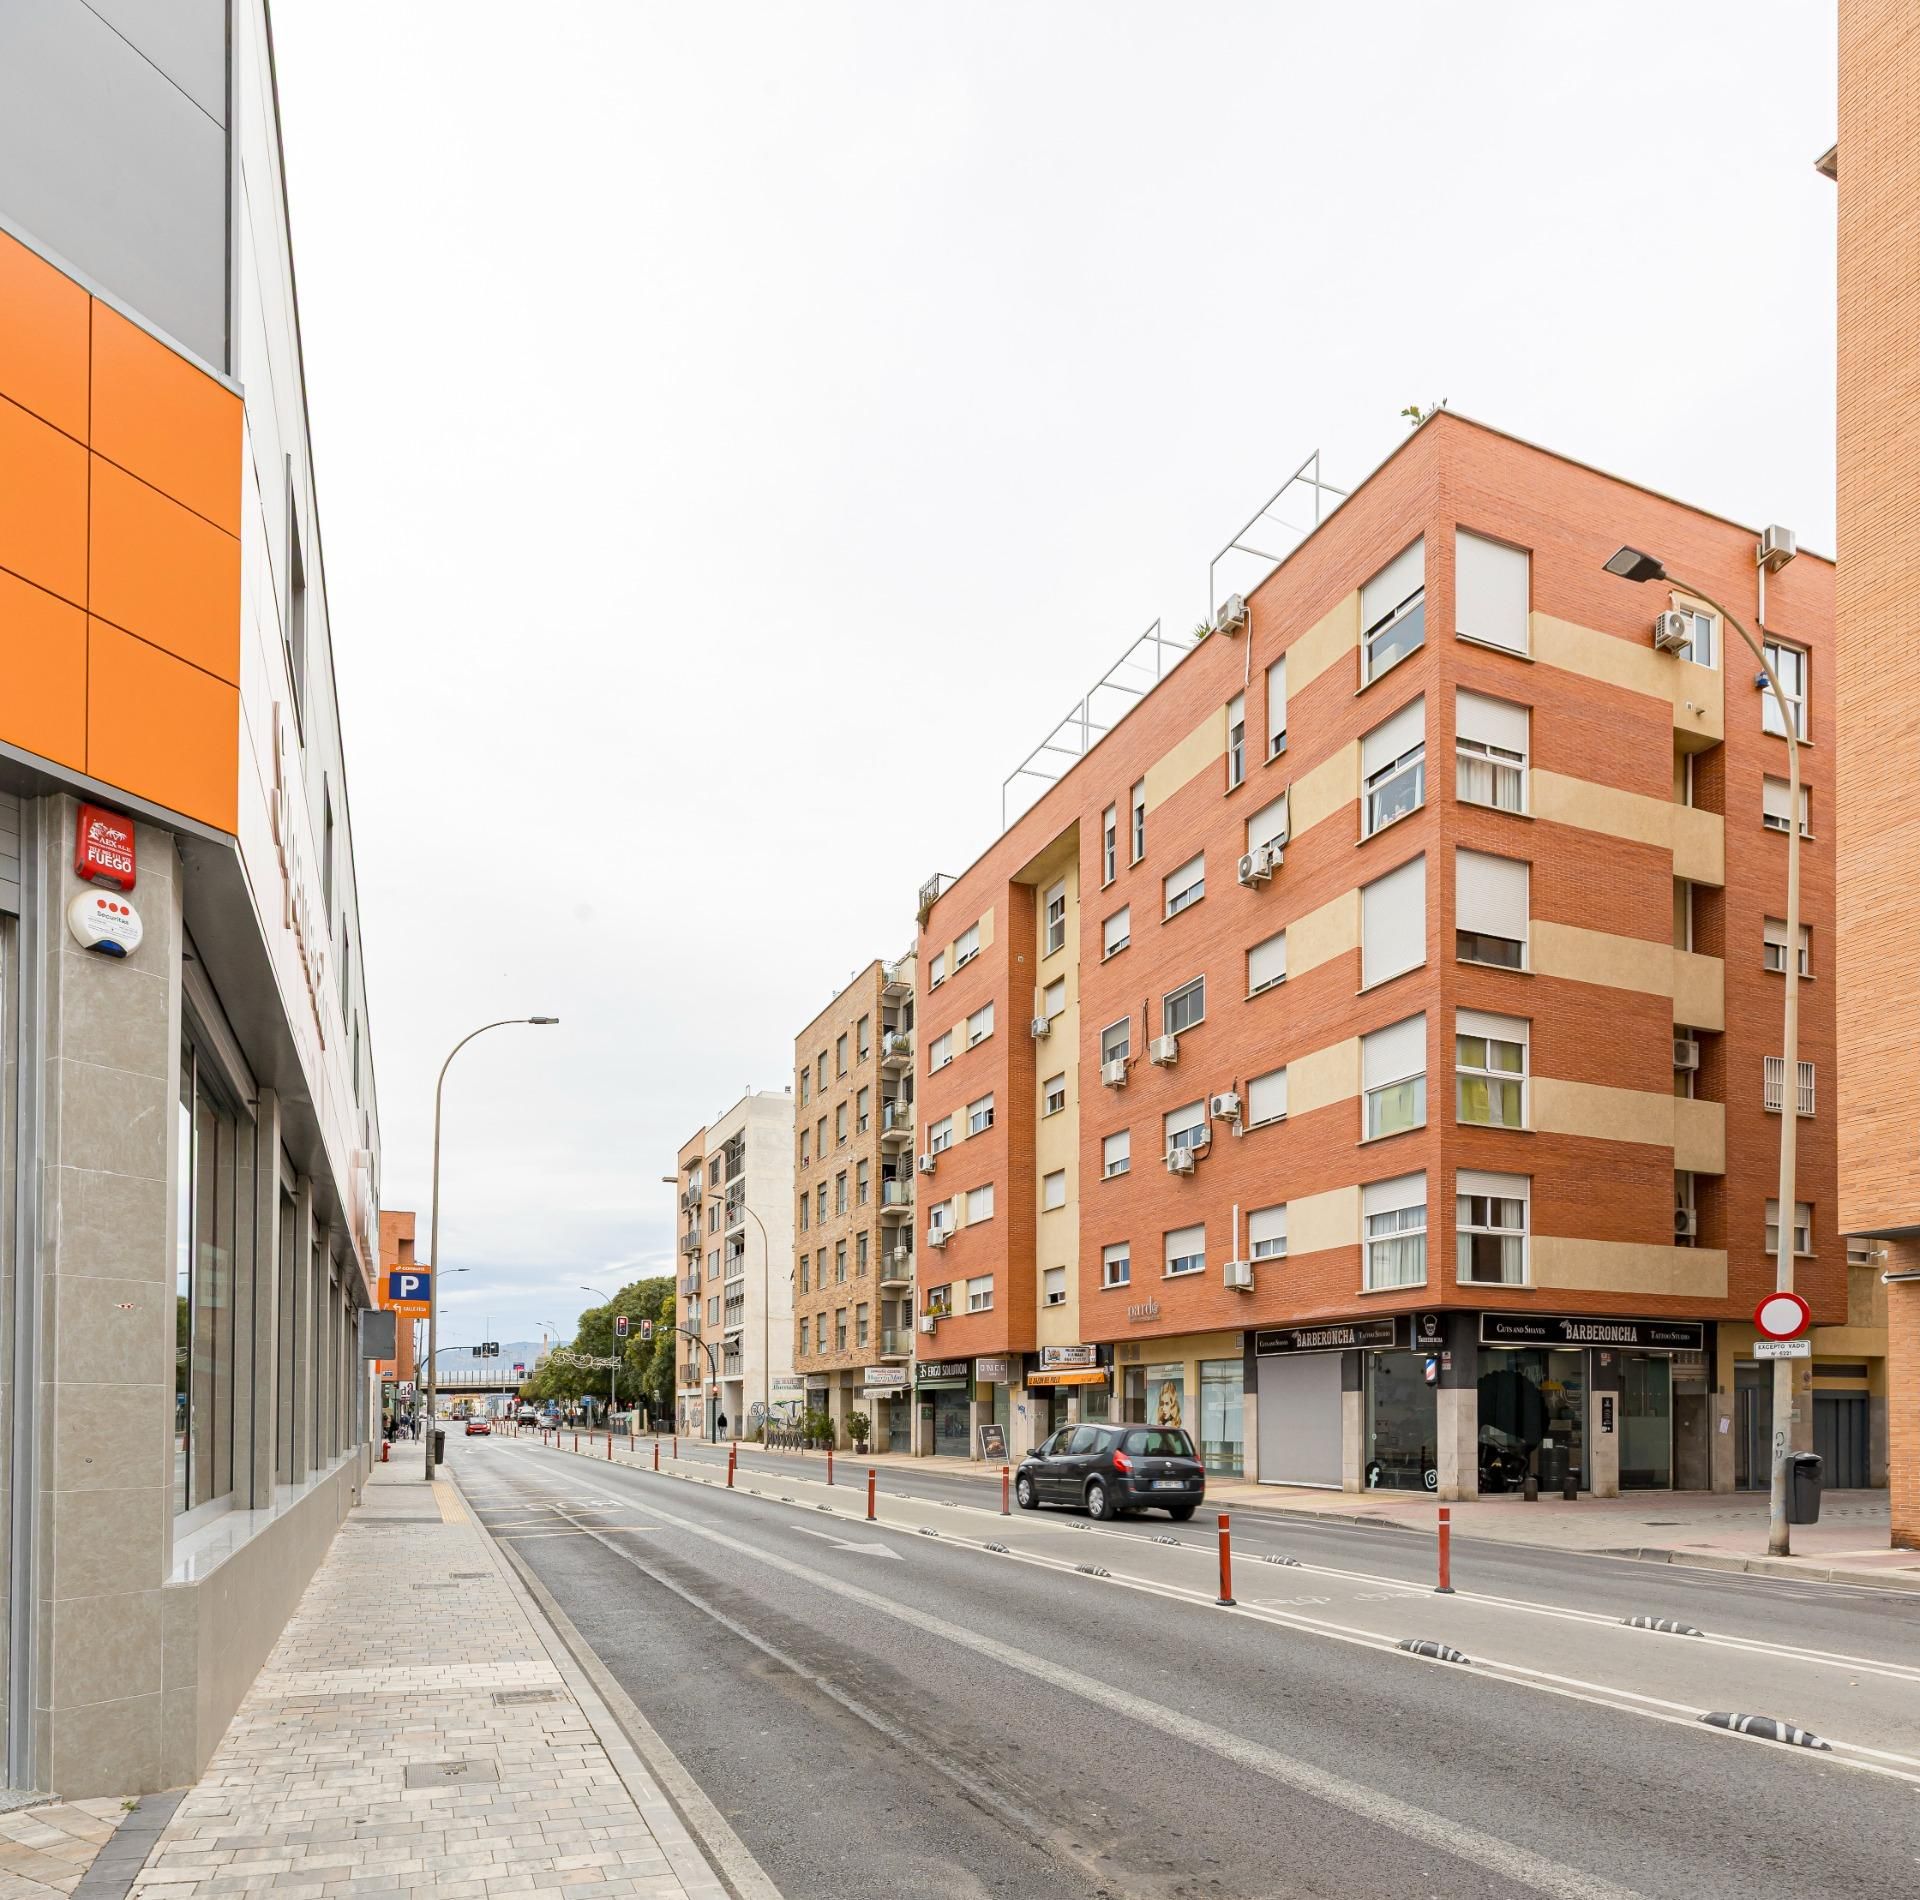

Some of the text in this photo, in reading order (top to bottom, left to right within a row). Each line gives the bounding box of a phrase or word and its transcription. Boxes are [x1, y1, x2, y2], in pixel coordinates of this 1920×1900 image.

[88, 850, 132, 873] FUEGO
[401, 1275, 419, 1298] P
[1296, 1329, 1355, 1348] BARBERONCHA
[1566, 1323, 1638, 1342] BARBERONCHA
[942, 1363, 968, 1376] SOLUTION
